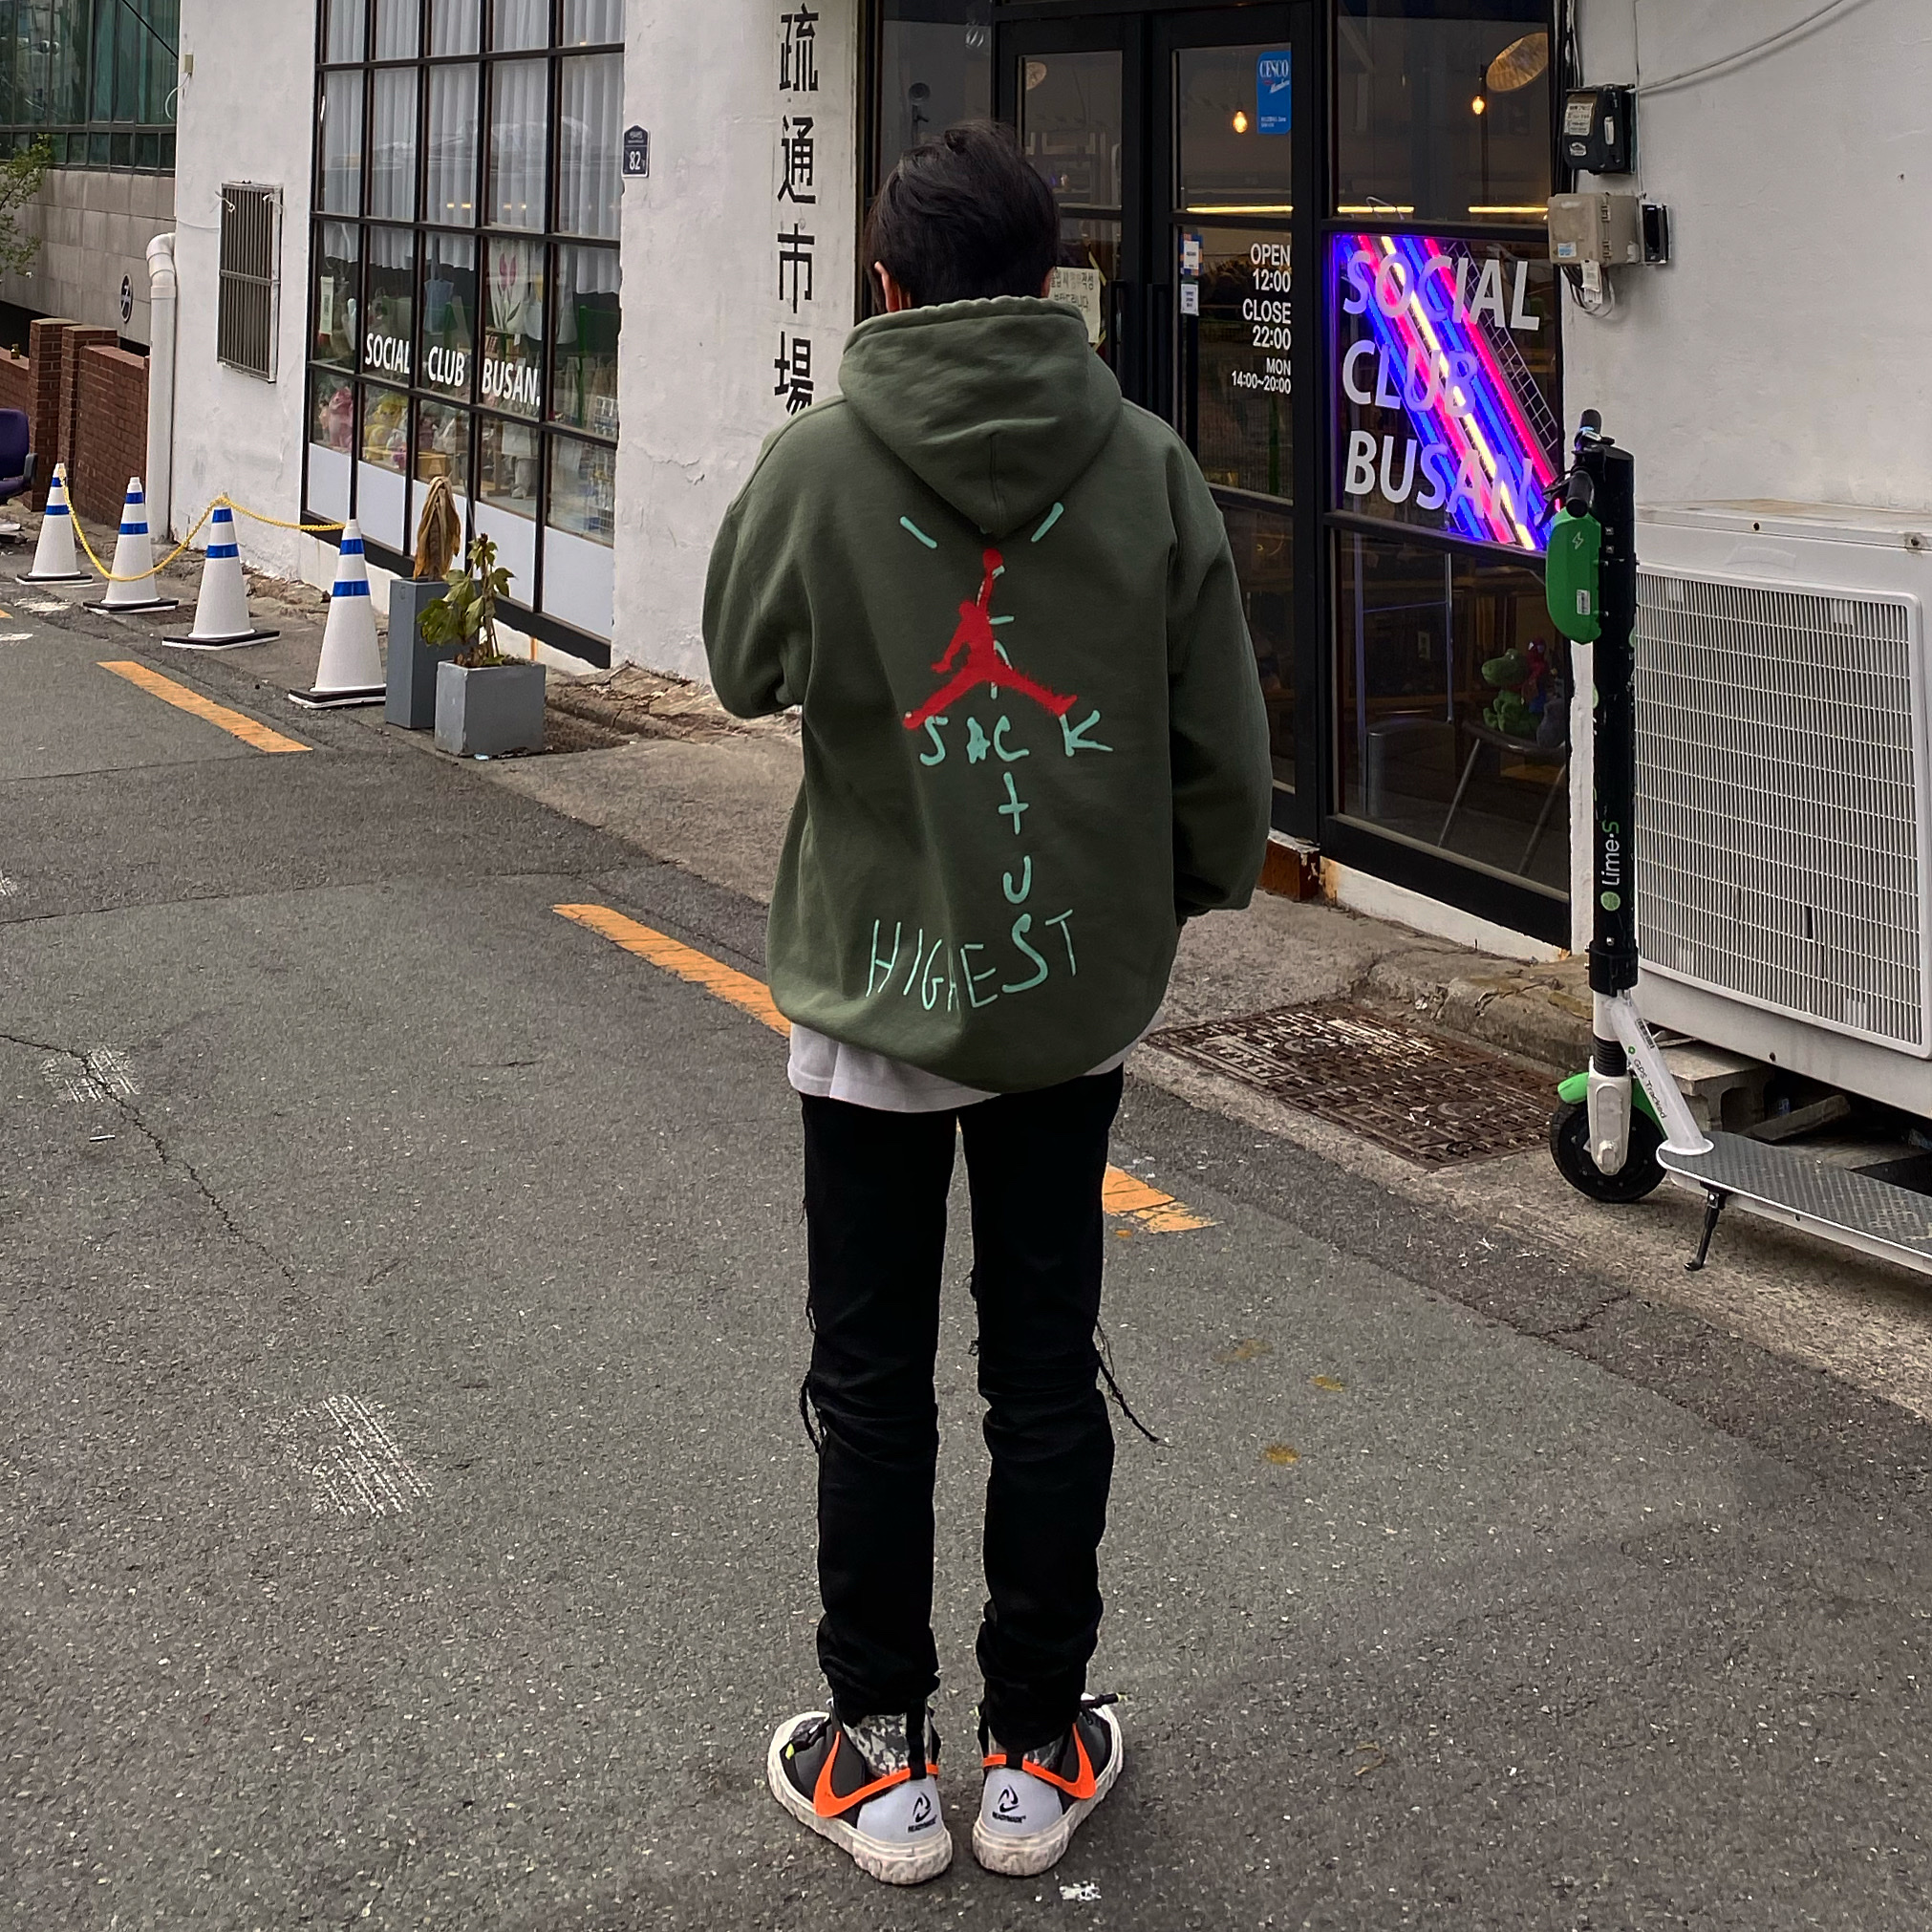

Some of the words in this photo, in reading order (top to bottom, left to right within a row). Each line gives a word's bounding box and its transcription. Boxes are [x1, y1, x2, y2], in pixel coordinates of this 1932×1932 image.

[629, 150, 641, 170] 82
[1250, 243, 1290, 267] OPEN
[1252, 268, 1291, 292] 12:00
[1342, 249, 1539, 331] SOCIAL
[1242, 297, 1291, 324] CLOSE
[1252, 324, 1291, 351] 22:00
[365, 333, 410, 375] SOCIAL
[428, 345, 465, 387] CLUB
[1266, 356, 1291, 376] MON
[1231, 370, 1291, 395] 14:00~20:00
[1342, 339, 1477, 418] CLUB
[1633, 1058, 1647, 1080] GPS
[1644, 1080, 1668, 1119] Tracked
